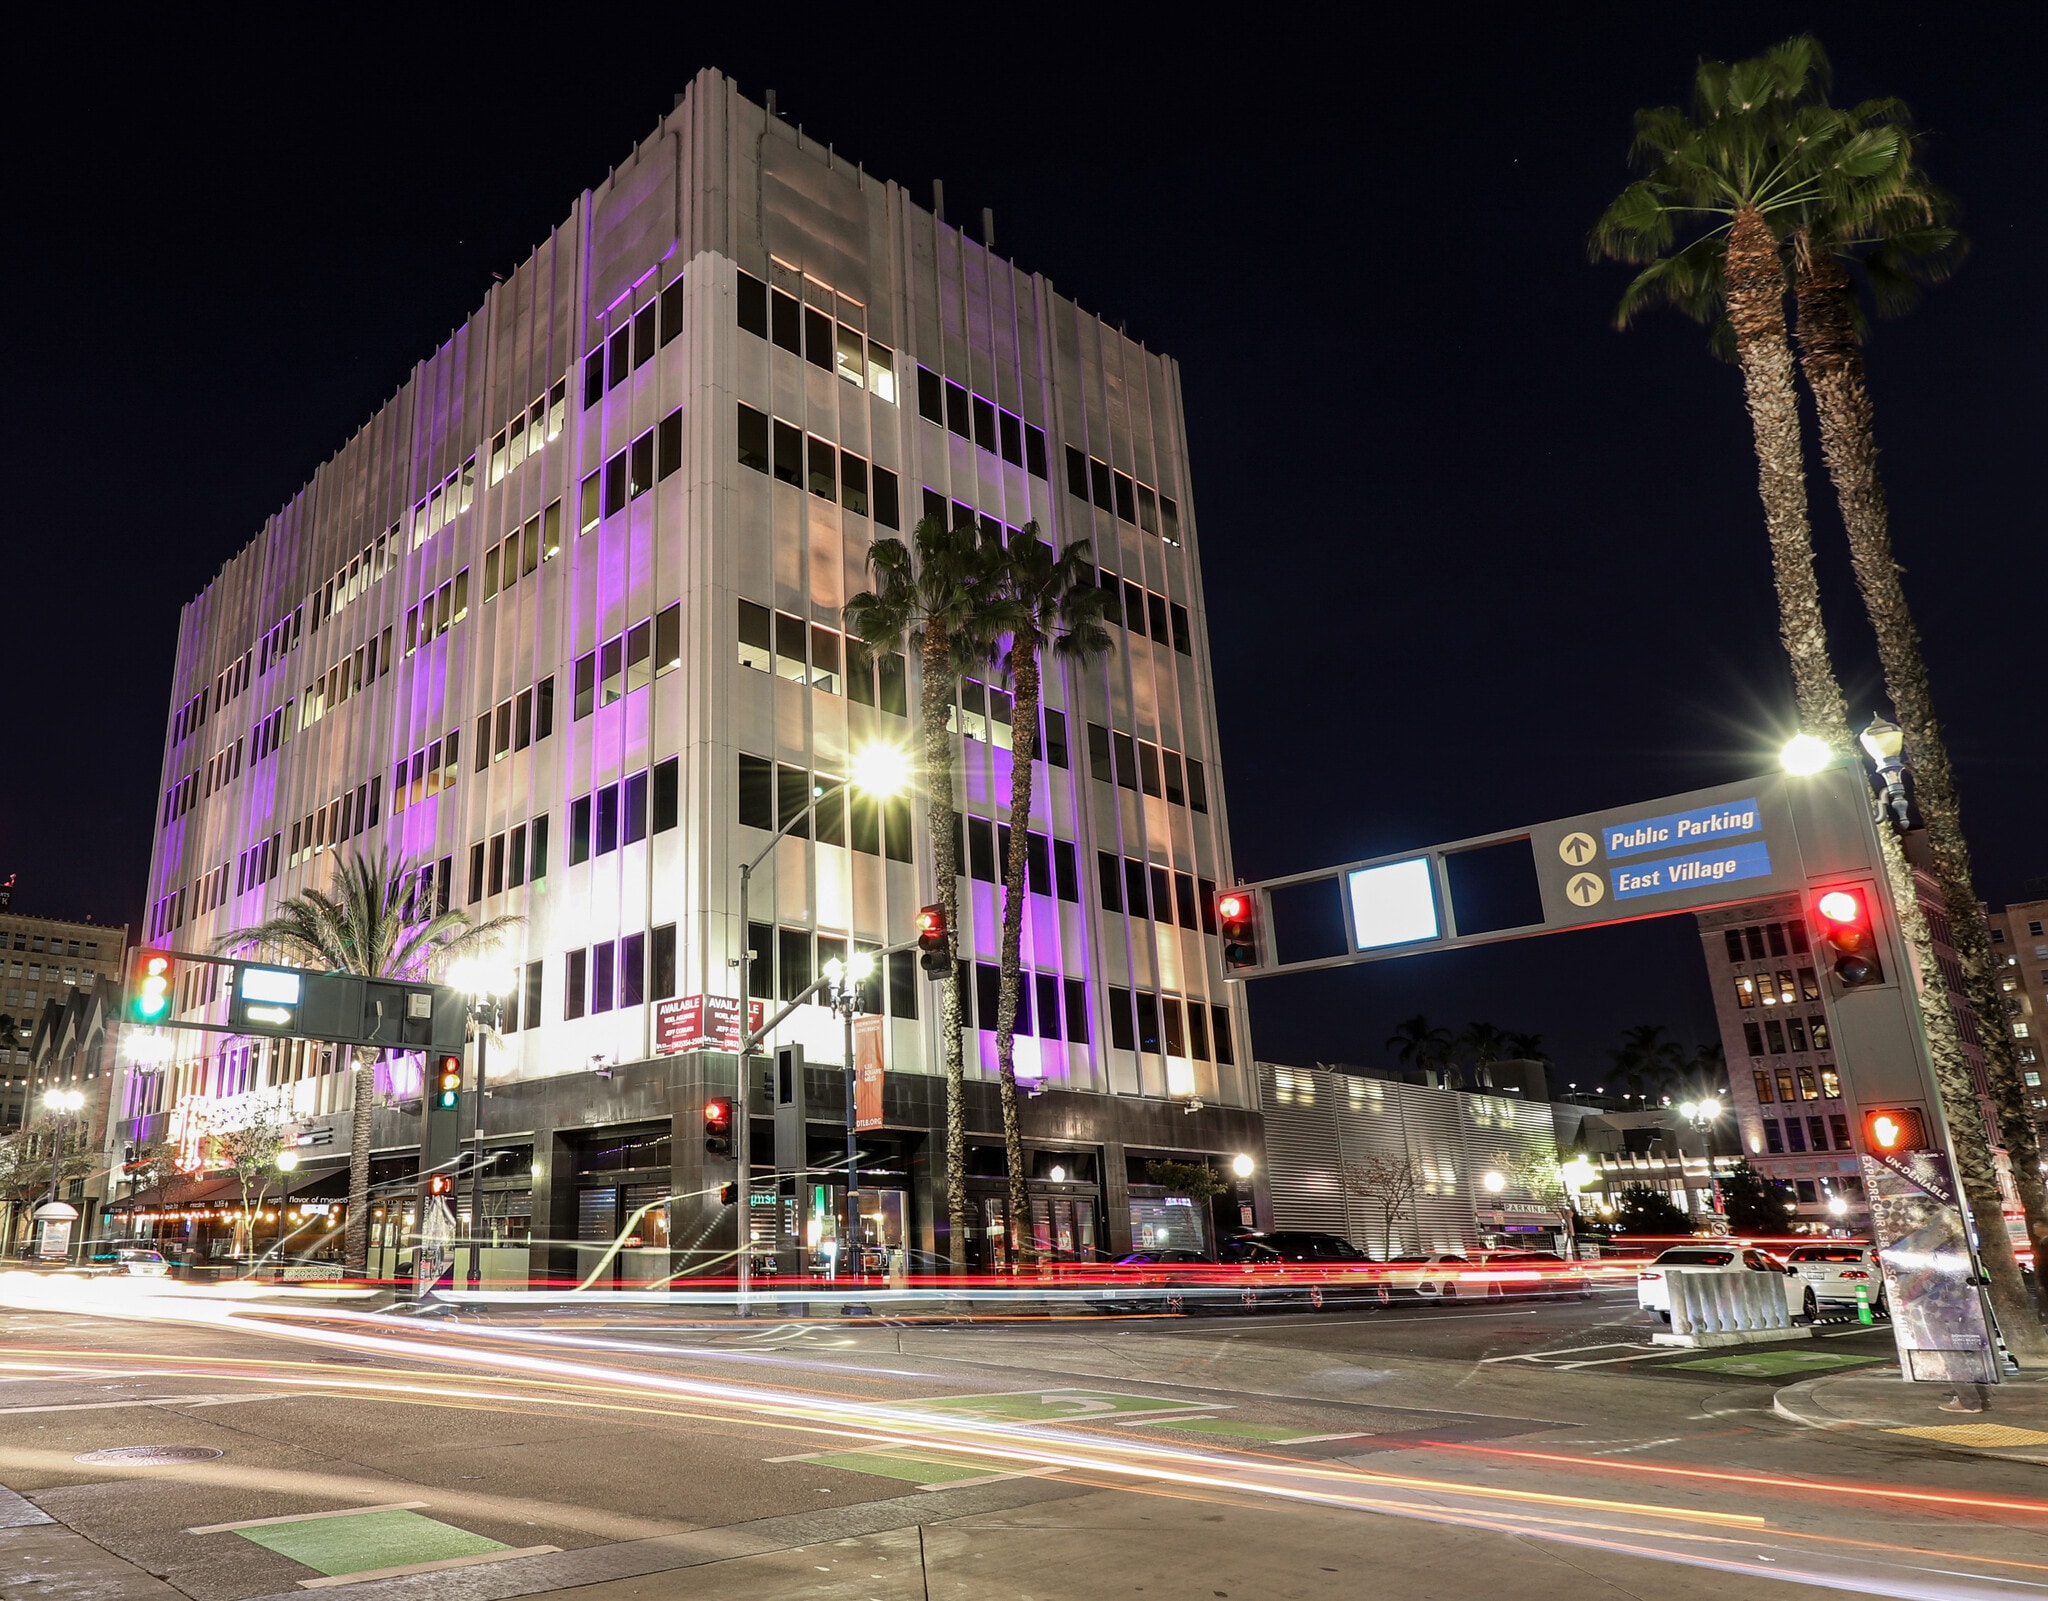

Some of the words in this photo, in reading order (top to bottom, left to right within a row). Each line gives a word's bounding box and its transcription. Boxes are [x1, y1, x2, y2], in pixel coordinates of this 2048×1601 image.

[1611, 827, 1668, 850] Public
[1677, 811, 1754, 838] Parking
[1619, 870, 1660, 892] East
[1668, 860, 1736, 883] Village
[660, 998, 700, 1015] AVAILABLE
[708, 997, 760, 1014] AVAILALE
[715, 1025, 729, 1033] JEFF
[856, 1117, 882, 1128] DTLB.ORG
[1885, 1155, 1950, 1201] UN-DENIABLE
[1861, 1155, 1881, 1201] EXPLORE
[1872, 1203, 1886, 1226] OUR
[320, 1196, 348, 1204] mexico
[1504, 1204, 1546, 1213] PARKING
